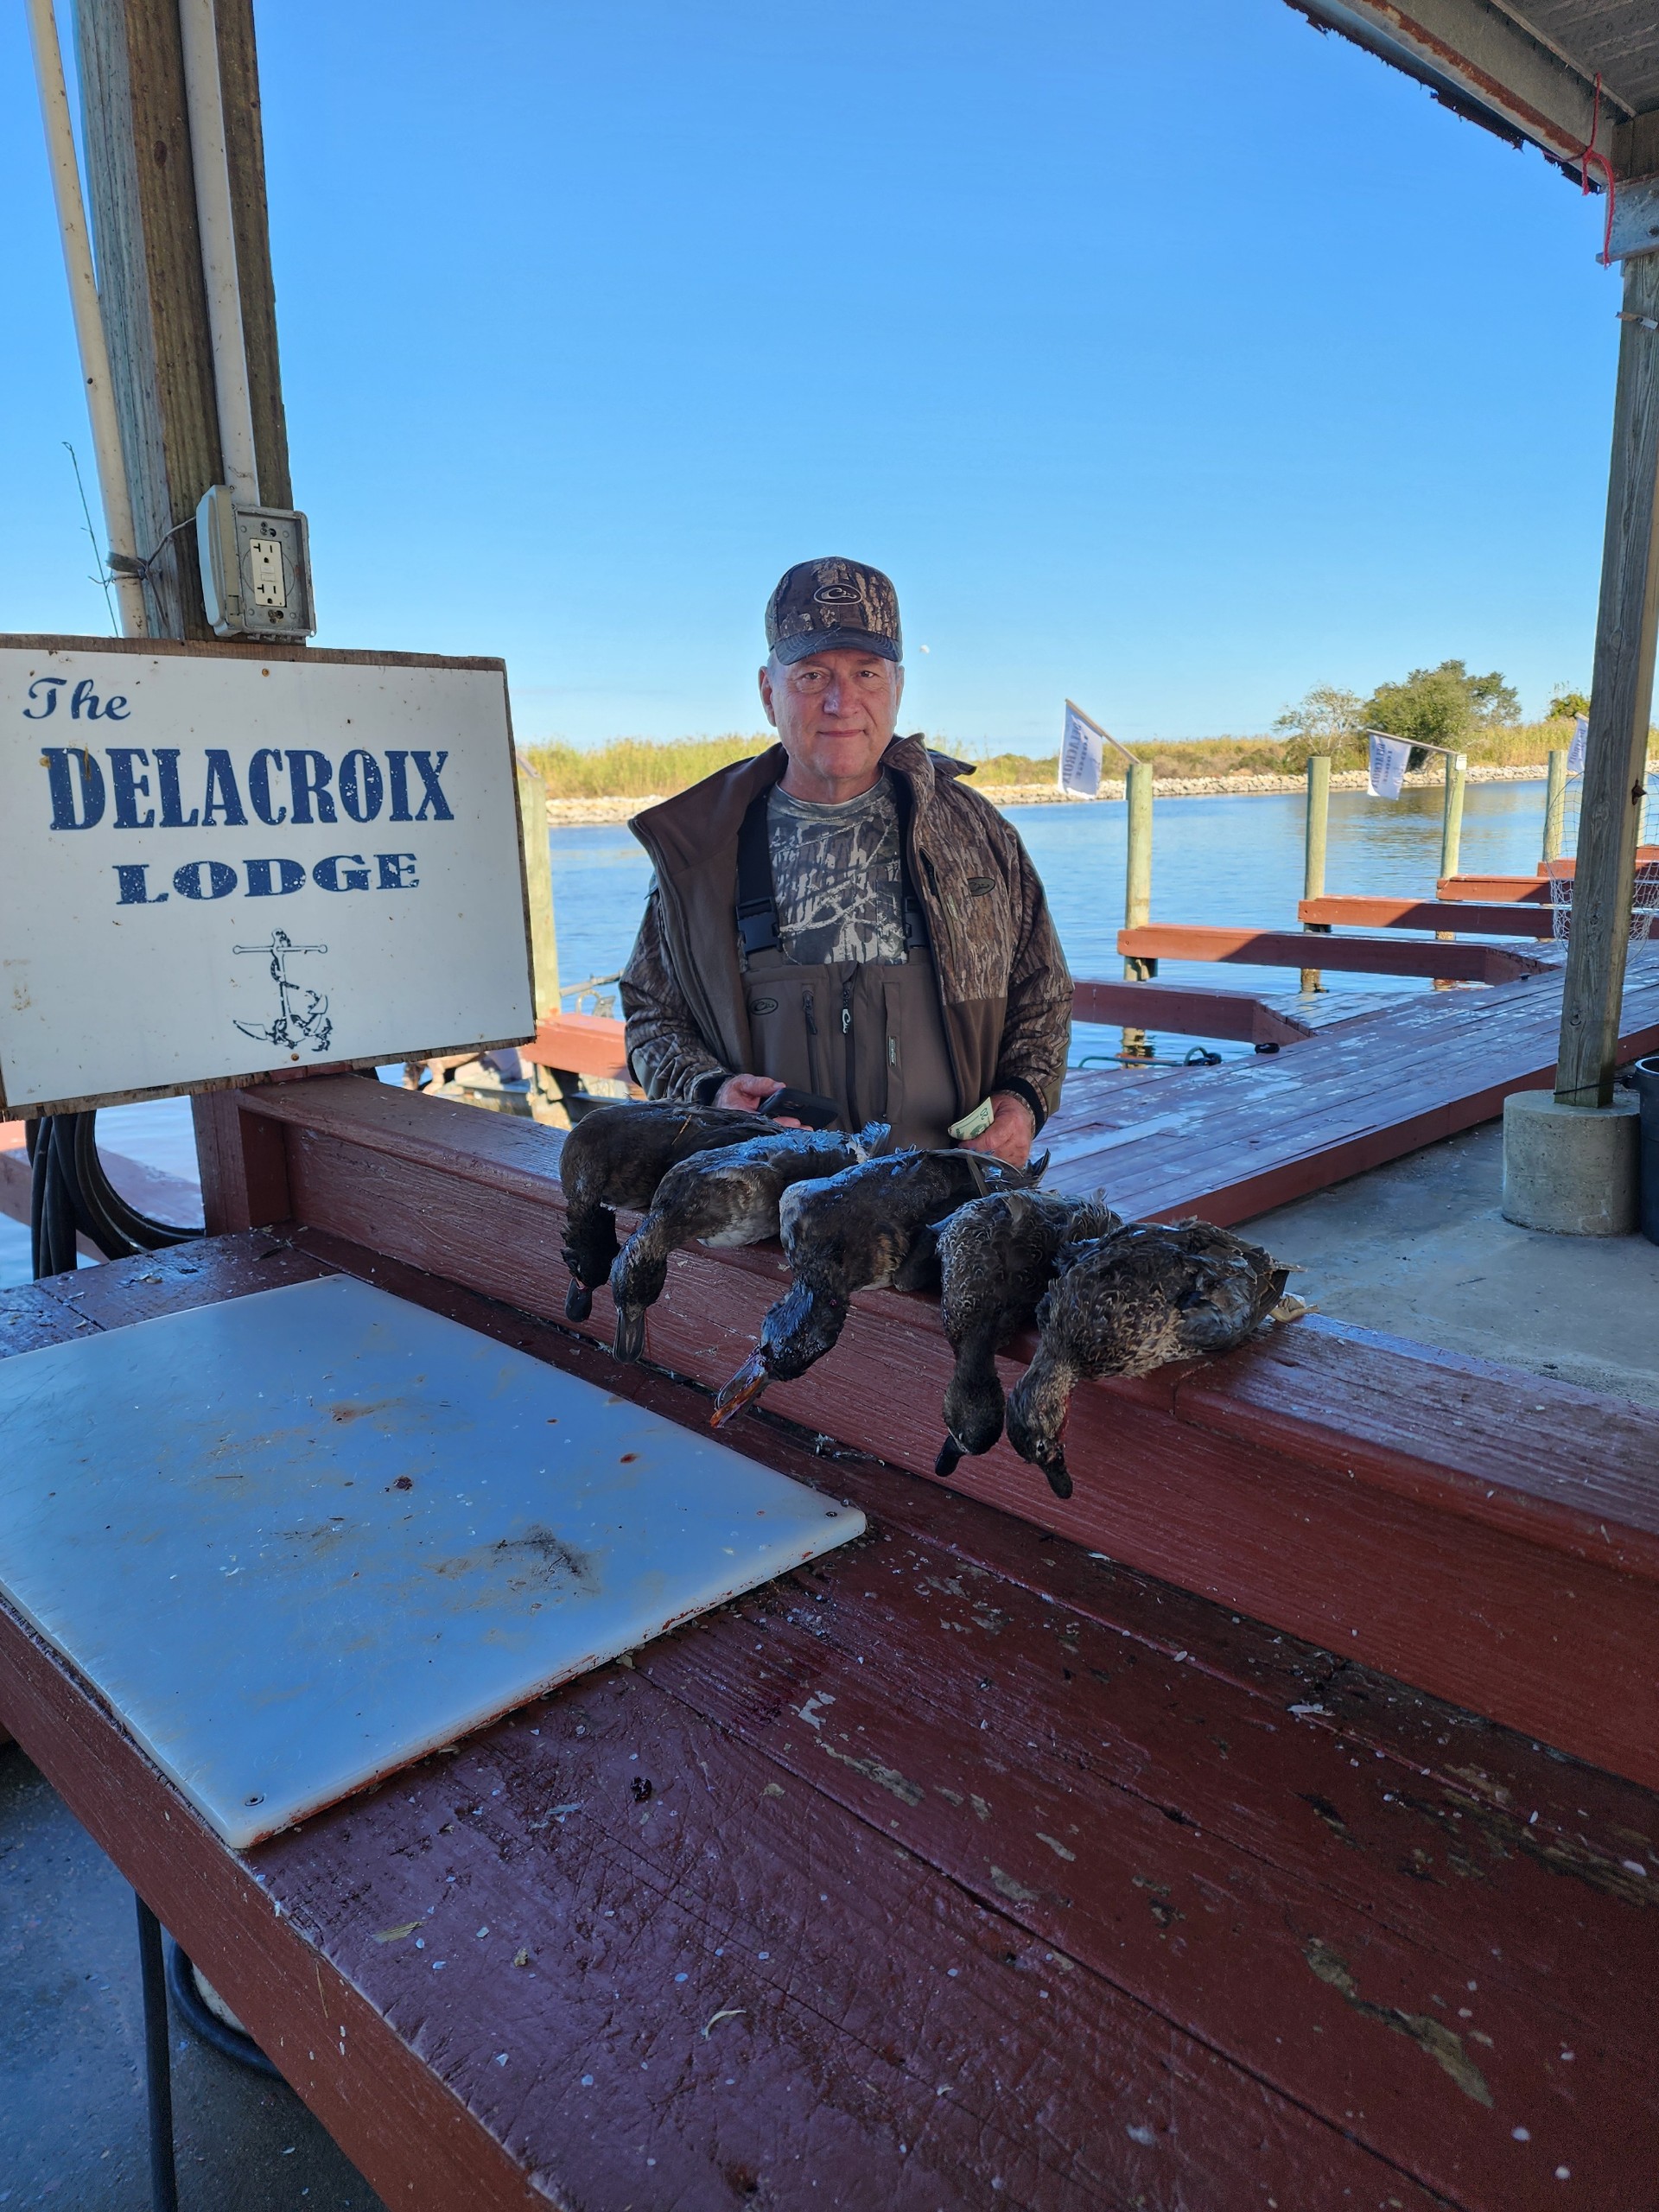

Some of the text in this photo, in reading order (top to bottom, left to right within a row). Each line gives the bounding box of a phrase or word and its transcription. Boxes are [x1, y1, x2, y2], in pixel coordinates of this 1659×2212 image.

[22, 677, 131, 721] The
[41, 747, 454, 831] DELACROIX
[112, 853, 420, 906] LODGE
